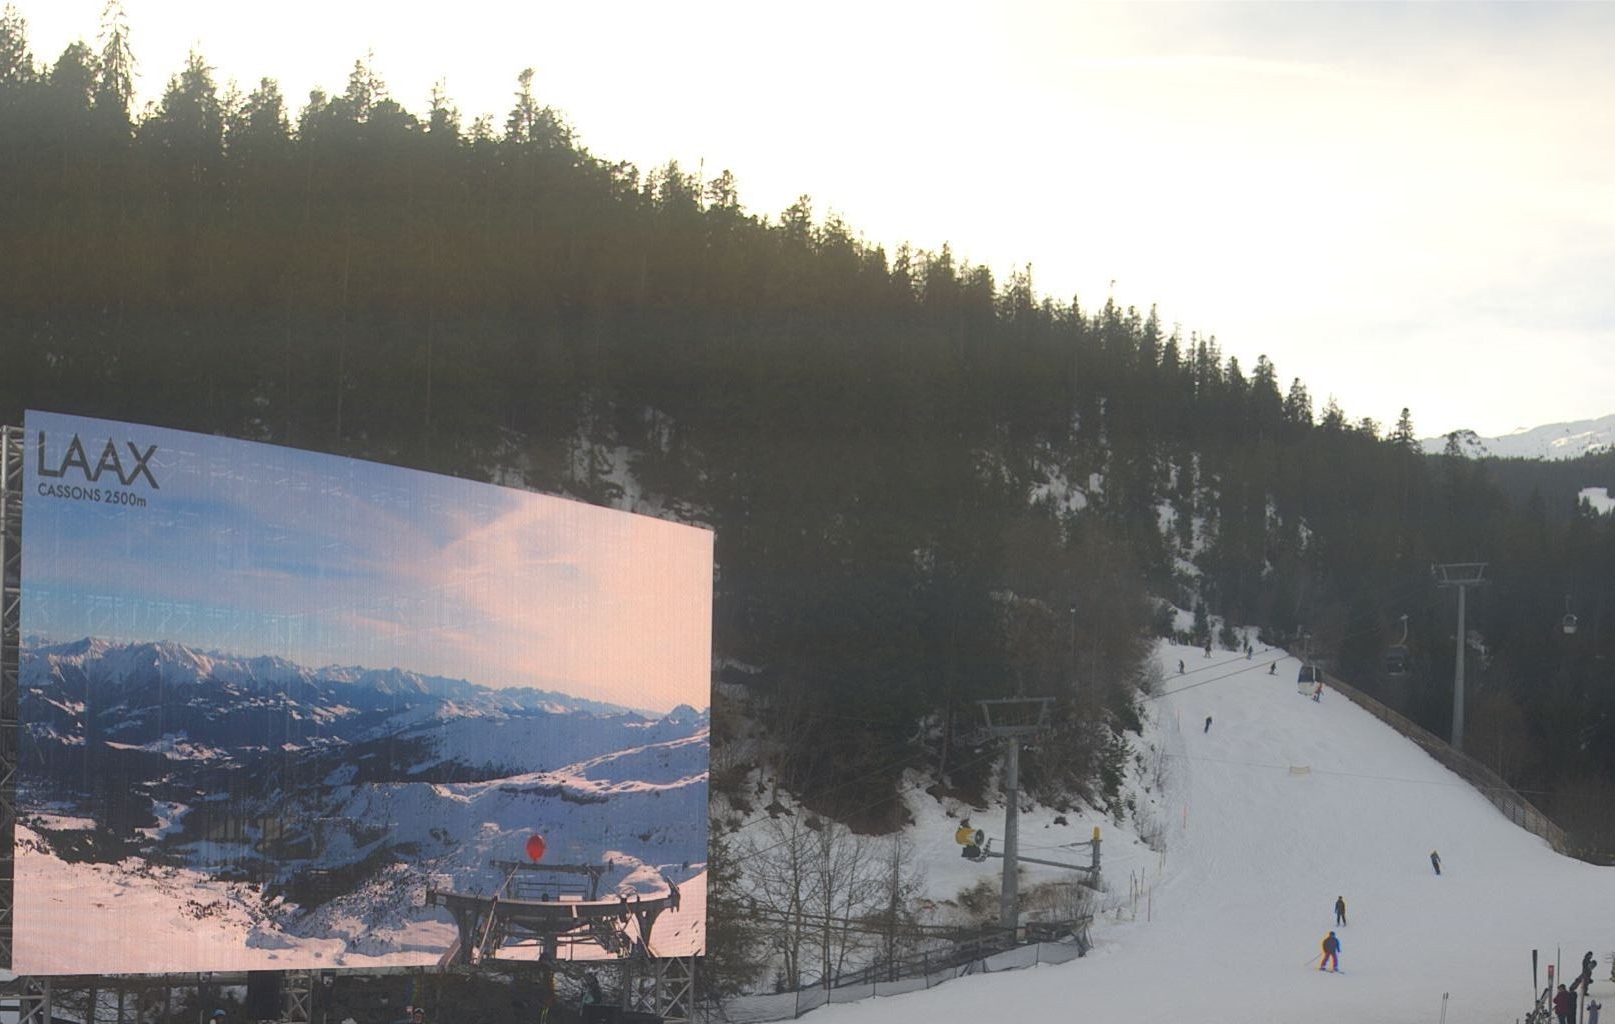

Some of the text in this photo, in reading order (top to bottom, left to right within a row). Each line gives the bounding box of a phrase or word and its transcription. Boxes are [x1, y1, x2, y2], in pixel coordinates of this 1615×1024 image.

[38, 431, 160, 490] LAAX
[37, 482, 147, 507] CASSONS 2500m
